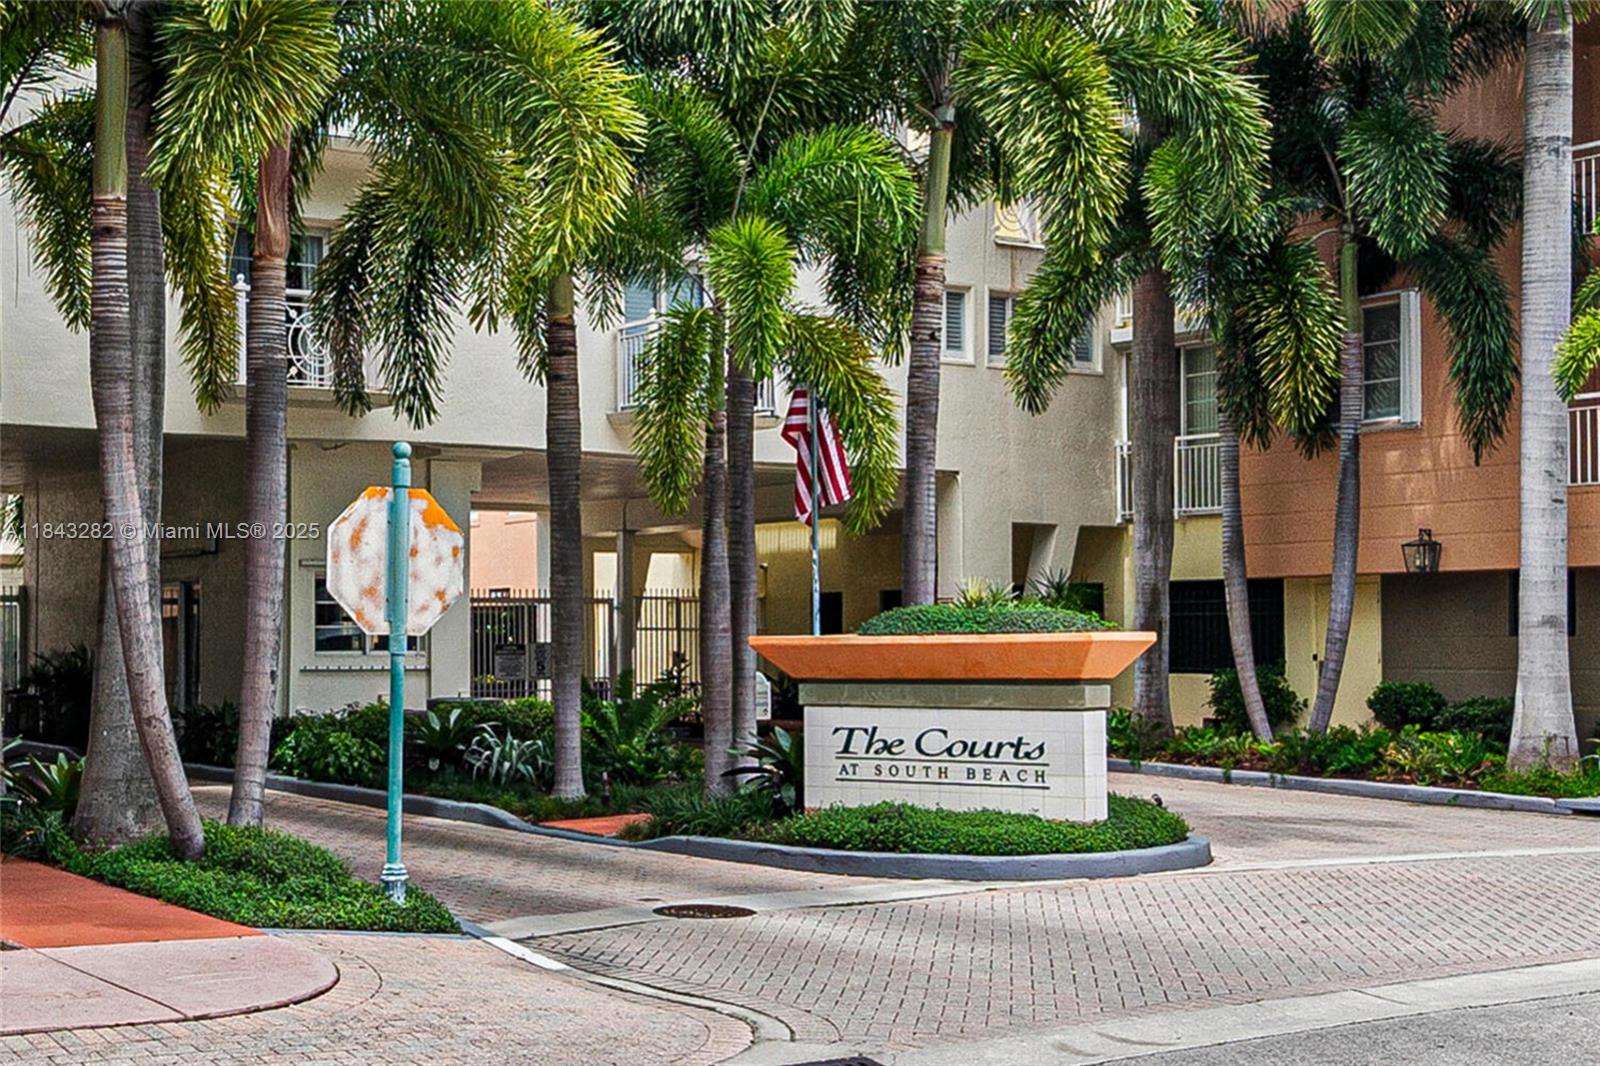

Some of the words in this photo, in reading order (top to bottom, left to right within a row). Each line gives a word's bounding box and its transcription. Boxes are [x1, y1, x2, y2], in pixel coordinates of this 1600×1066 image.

[832, 726, 905, 756] The
[914, 728, 1046, 760] Courts
[839, 763, 859, 776] AT
[874, 764, 949, 780] SOUTH
[966, 768, 1047, 784] BEACH
